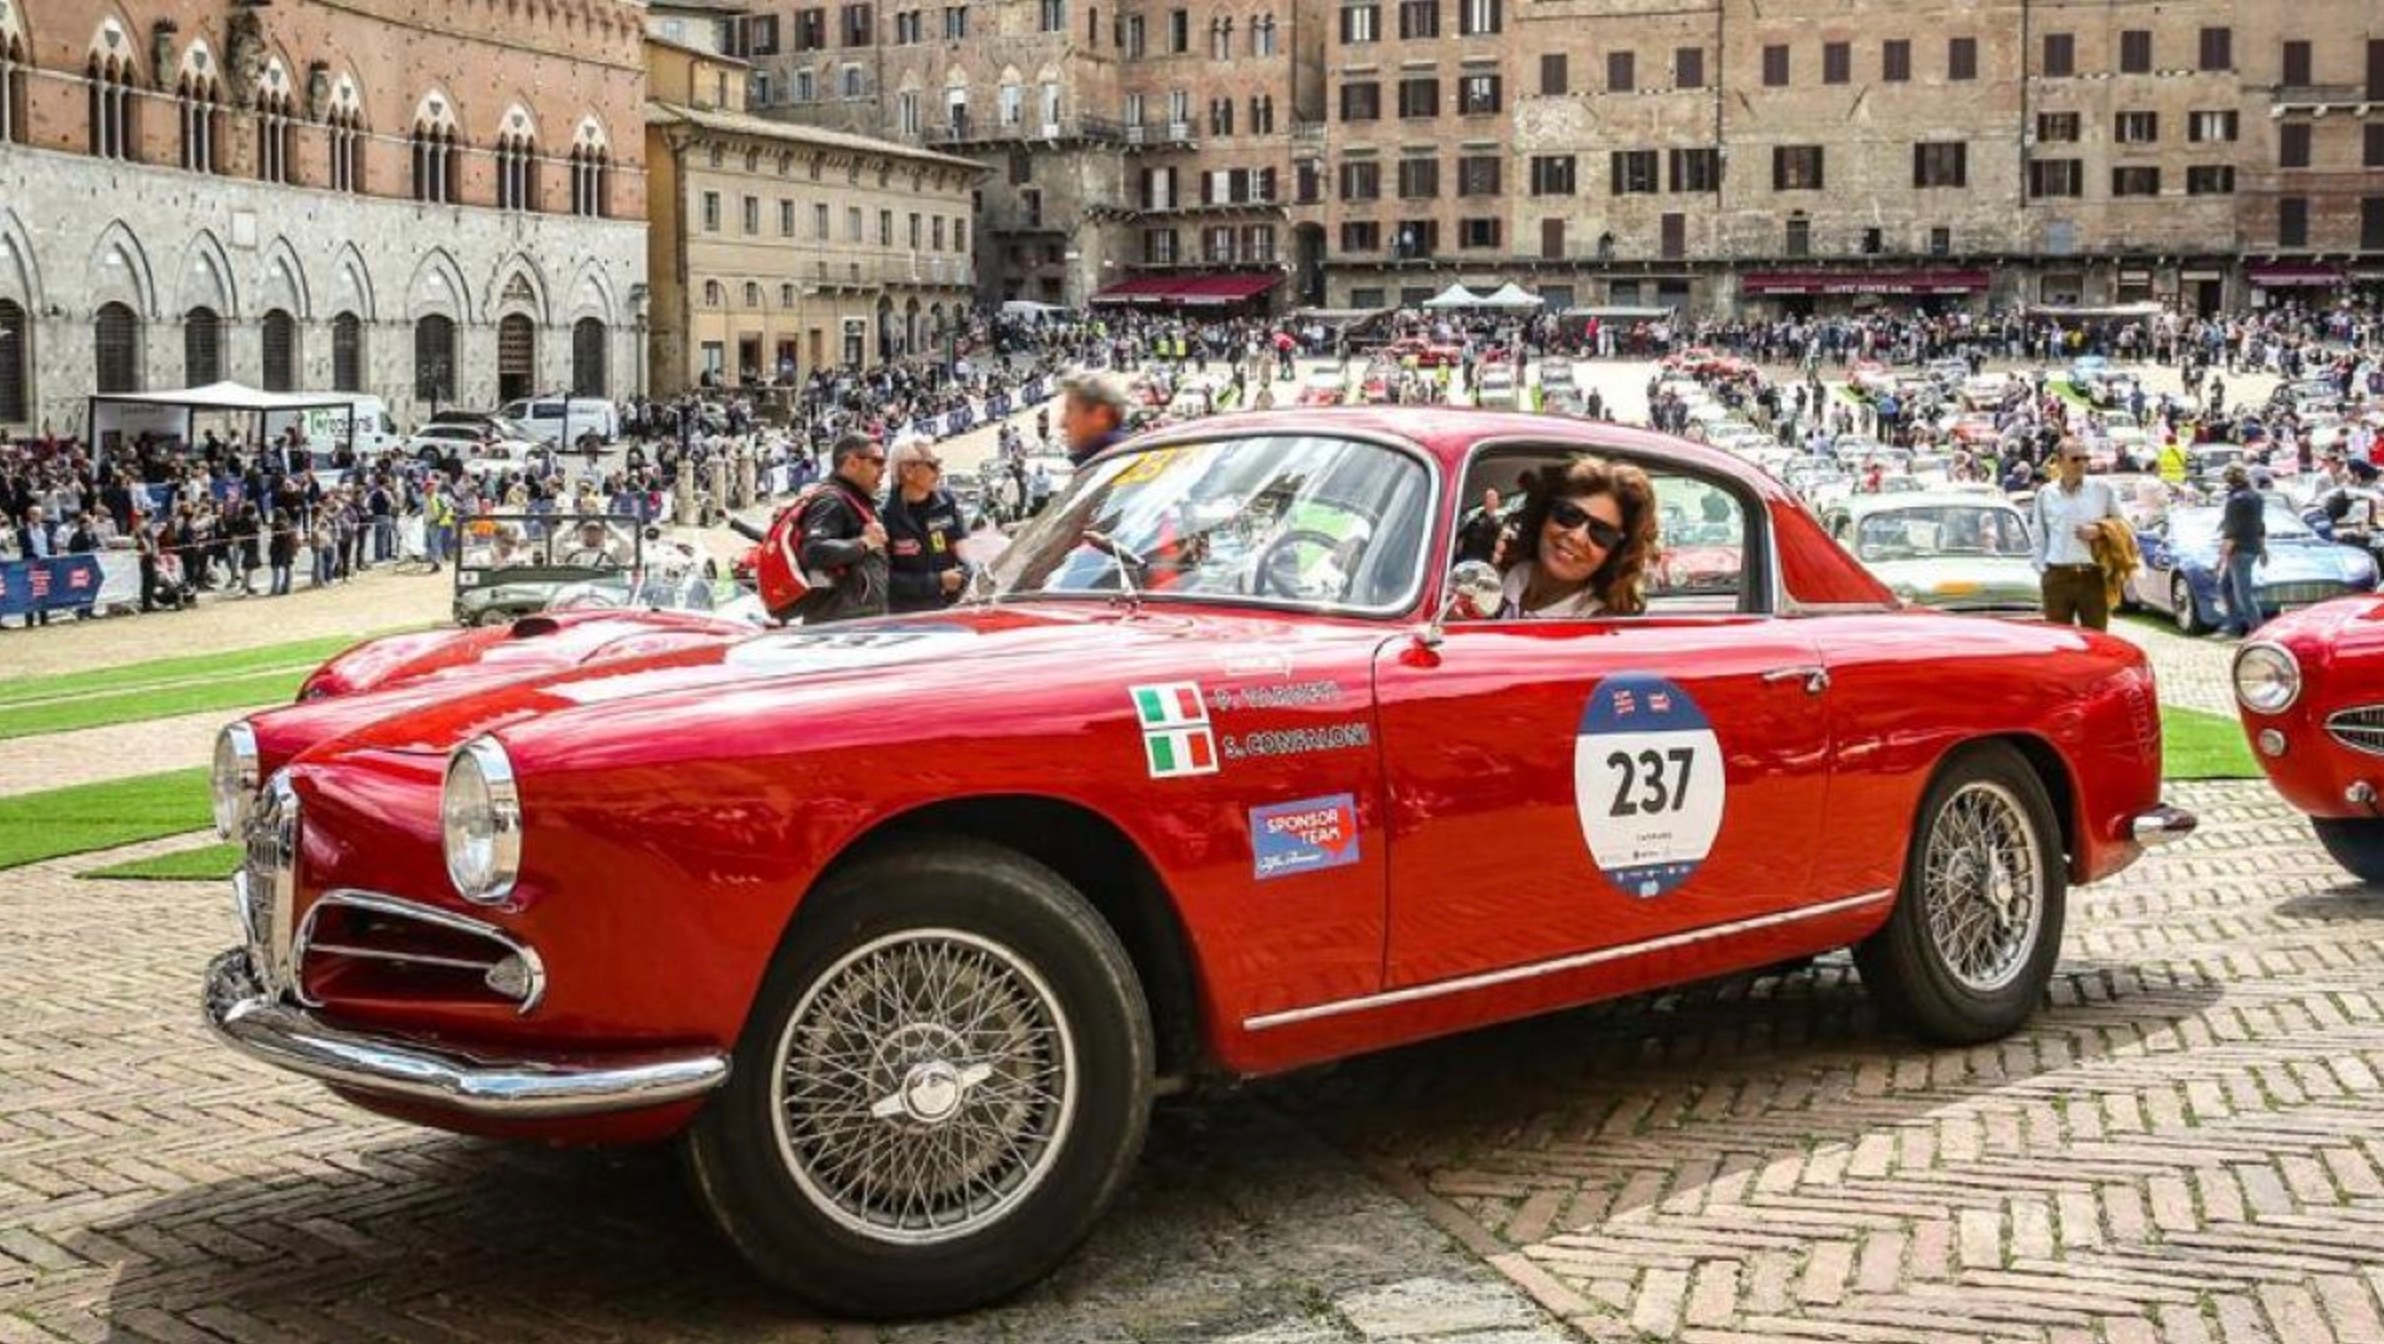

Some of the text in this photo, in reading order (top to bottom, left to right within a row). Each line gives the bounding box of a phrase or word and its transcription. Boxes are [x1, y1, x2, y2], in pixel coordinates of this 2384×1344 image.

[1606, 747, 1695, 817] 237
[1266, 808, 1338, 834] SPONSOR
[1300, 826, 1341, 845] TEAM
